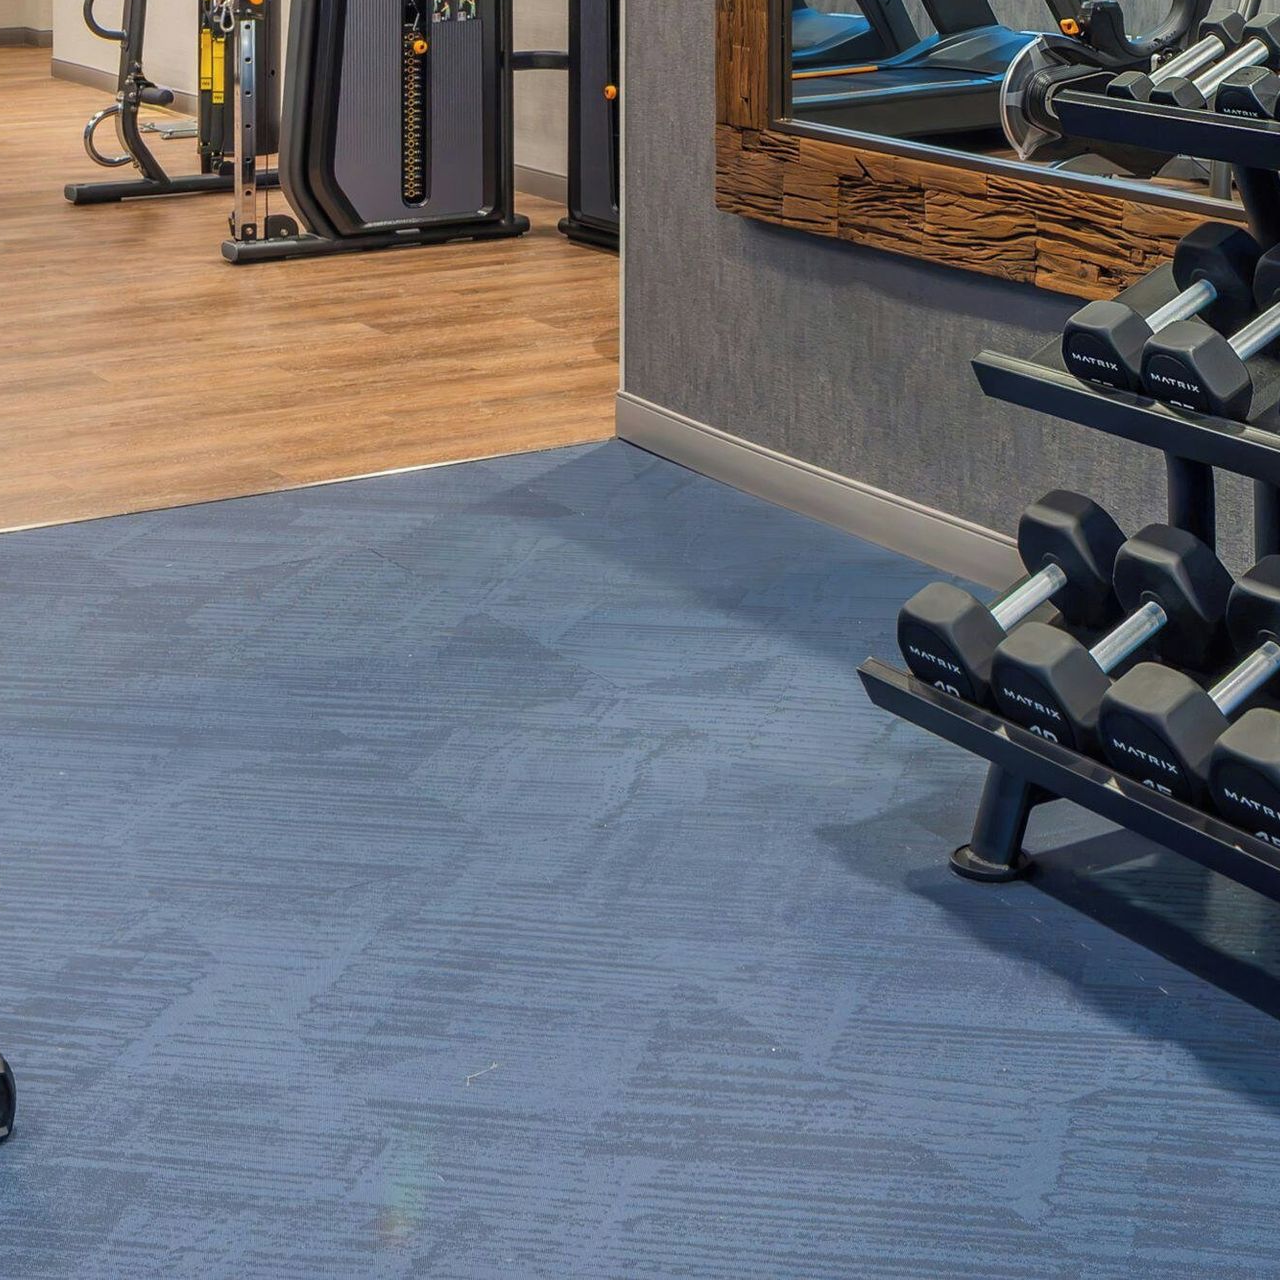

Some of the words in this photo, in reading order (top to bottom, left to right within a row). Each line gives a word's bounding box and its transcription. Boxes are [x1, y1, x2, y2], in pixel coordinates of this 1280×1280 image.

[1223, 107, 1259, 118] MATRIX
[1072, 352, 1119, 371] MATRIX
[1150, 372, 1200, 393] MATRIX
[909, 645, 962, 675] MATRIX
[1003, 687, 1061, 721] MATRIX
[1113, 738, 1178, 775] MATRIX
